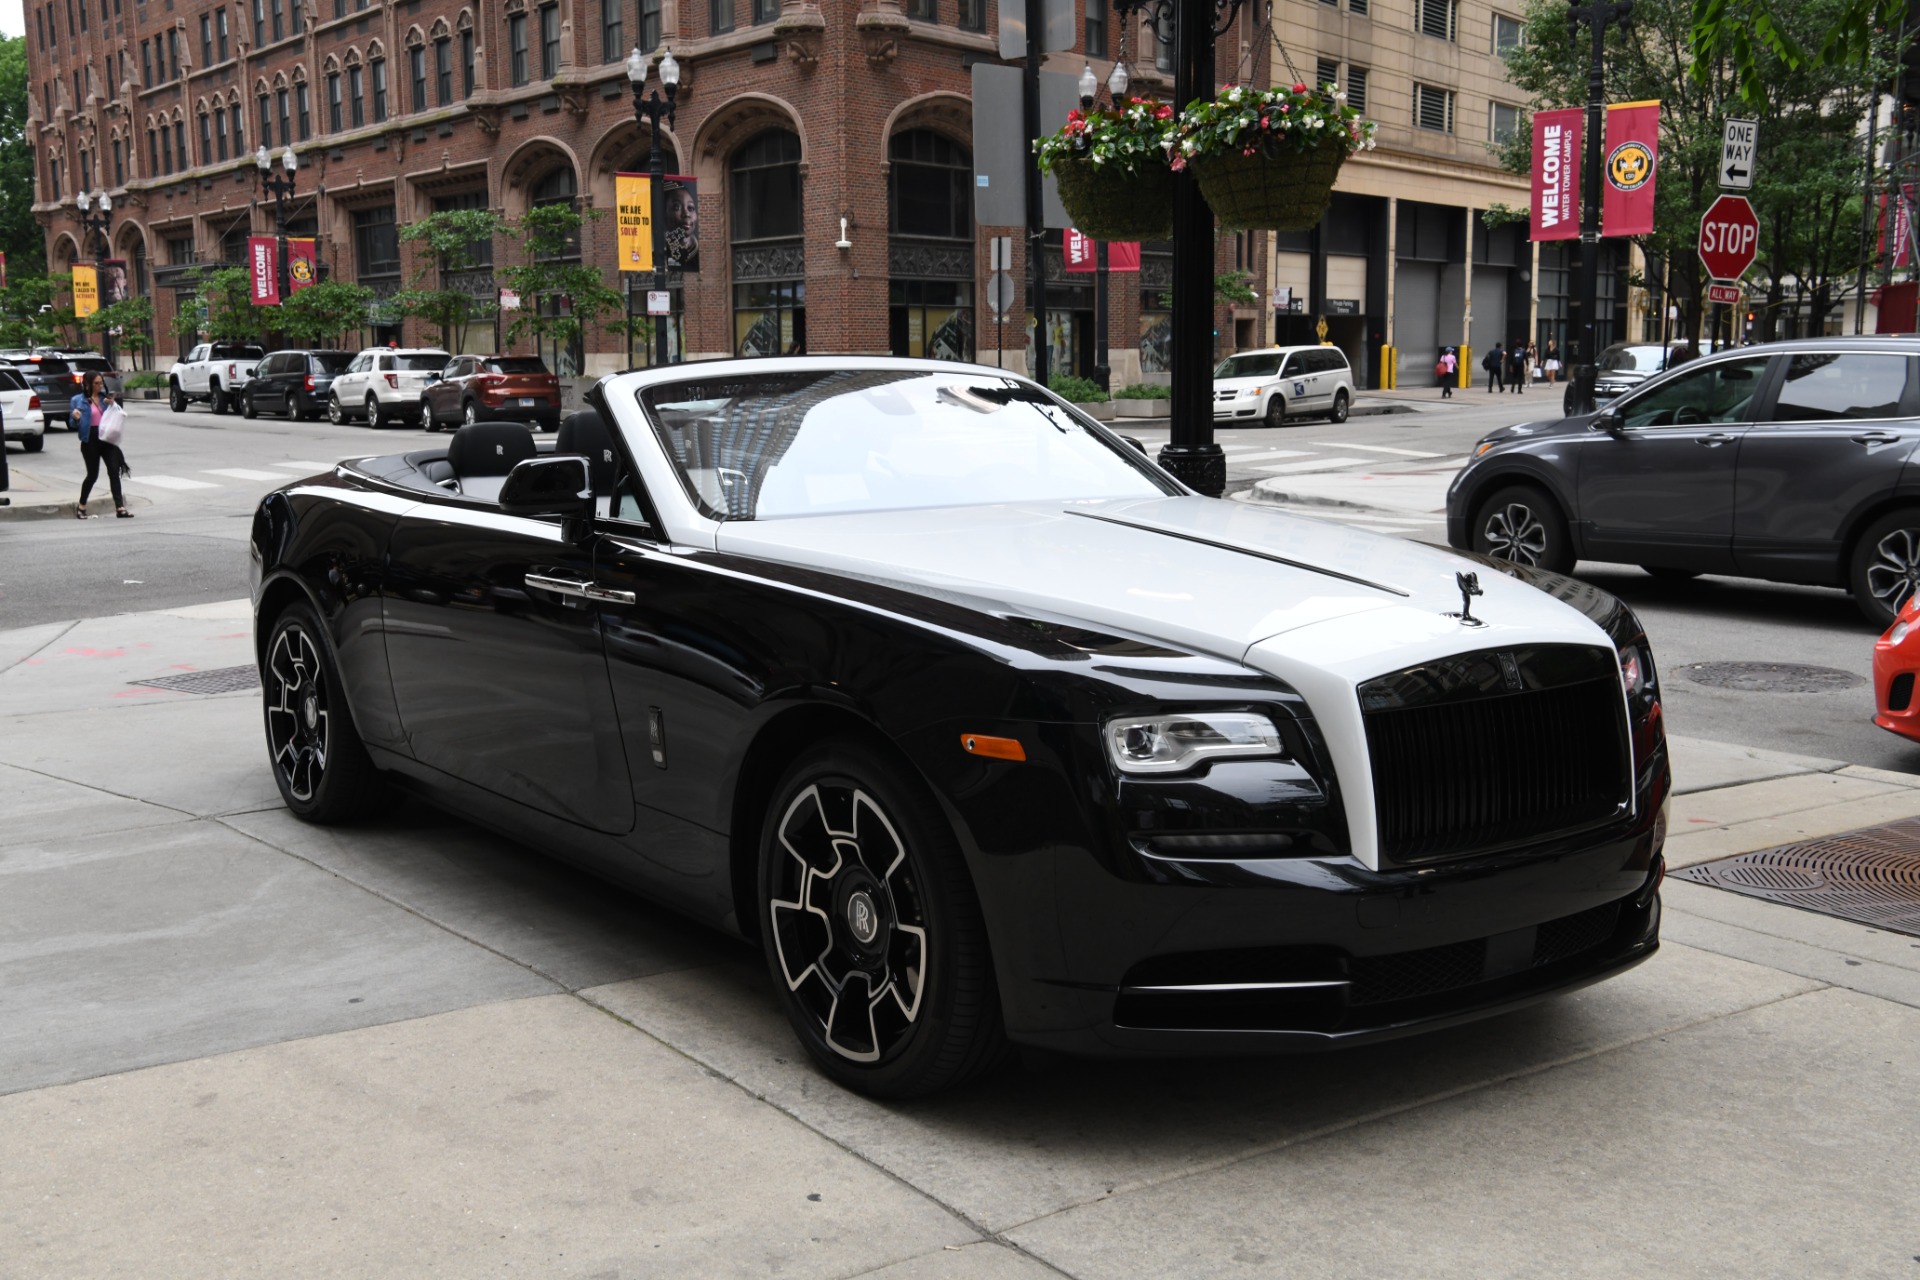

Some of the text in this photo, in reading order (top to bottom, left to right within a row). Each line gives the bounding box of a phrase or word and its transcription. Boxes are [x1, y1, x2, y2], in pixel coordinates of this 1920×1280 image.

[1728, 125, 1753, 143] ONE
[1726, 143, 1752, 162] WAY
[1541, 124, 1561, 229] WELCOME
[1562, 129, 1573, 220] WATER TOWER CAMPUS
[620, 205, 641, 215] WE ARE
[620, 216, 649, 225] CALLED TO
[620, 227, 638, 236] SOLVE
[1703, 221, 1755, 255] STOP
[254, 244, 268, 299] WELCOME
[1711, 288, 1737, 301] ALL WAY
